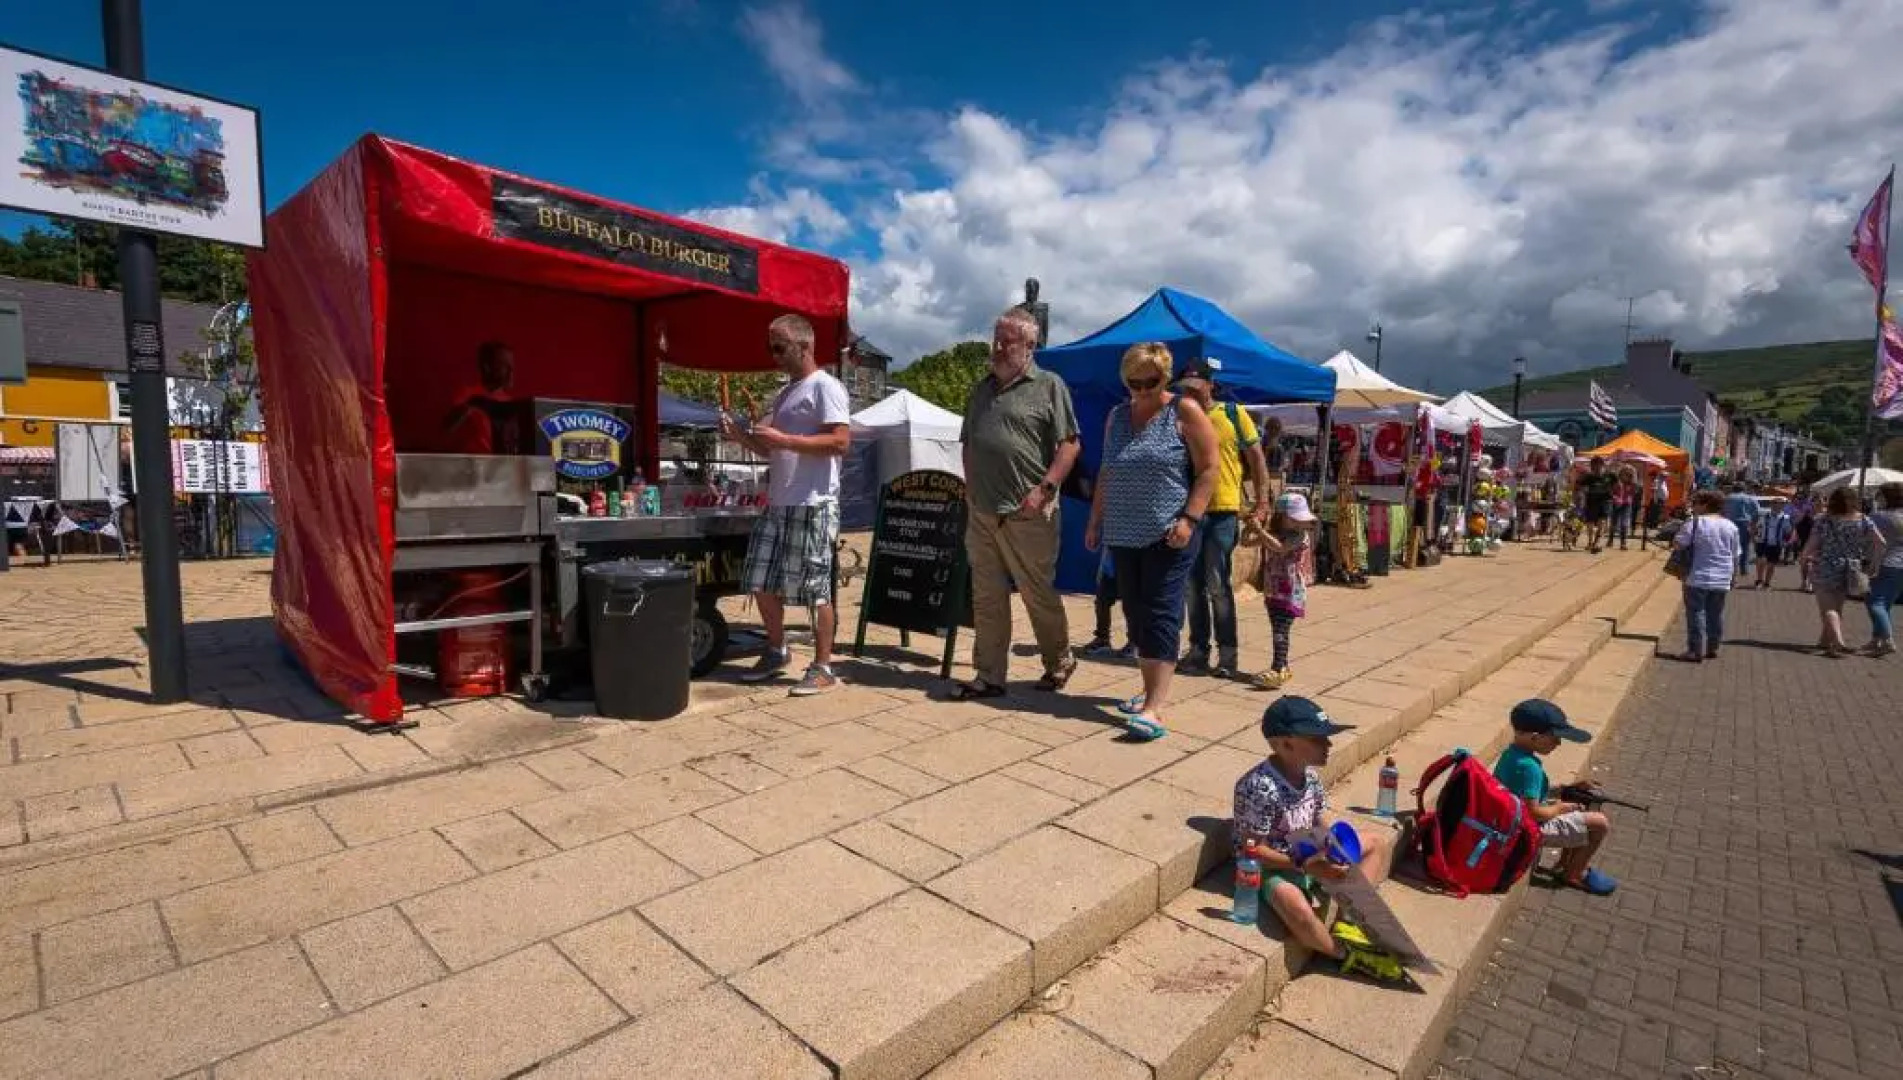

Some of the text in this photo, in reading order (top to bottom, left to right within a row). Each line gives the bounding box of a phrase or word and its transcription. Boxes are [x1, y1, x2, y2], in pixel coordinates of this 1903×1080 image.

[538, 206, 730, 273] BUFFALO BURGER
[550, 413, 624, 437] TWOMEY
